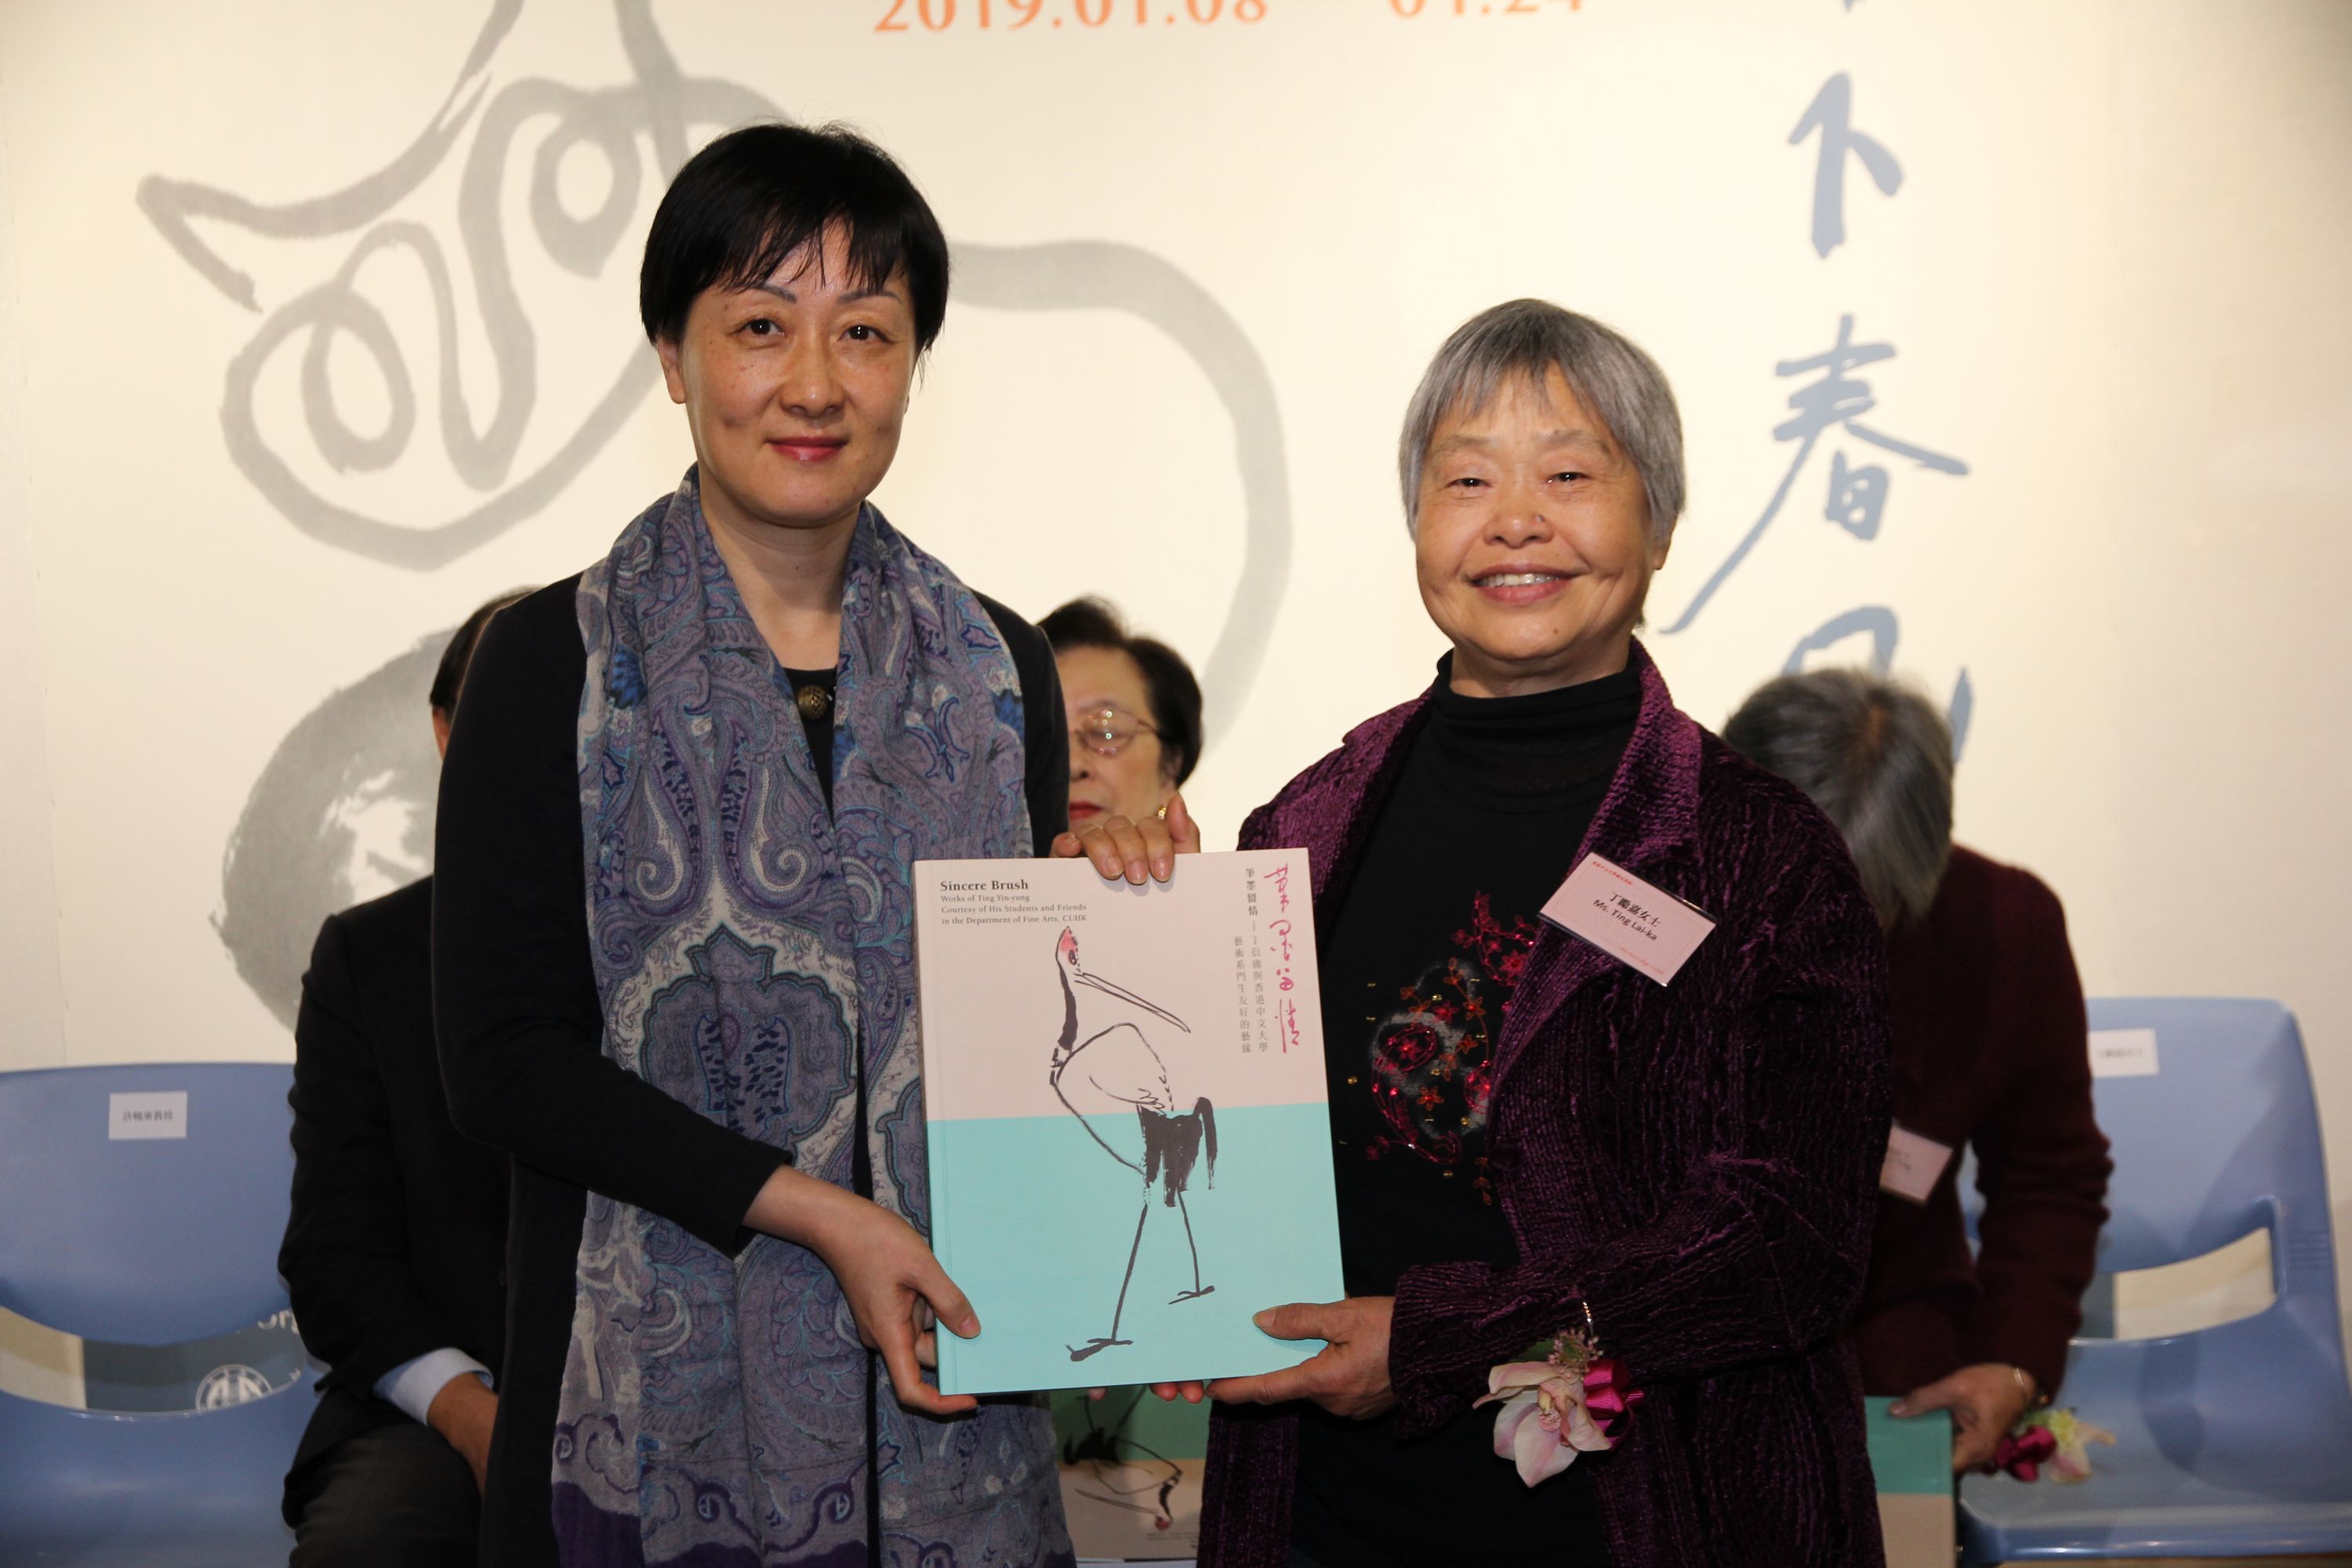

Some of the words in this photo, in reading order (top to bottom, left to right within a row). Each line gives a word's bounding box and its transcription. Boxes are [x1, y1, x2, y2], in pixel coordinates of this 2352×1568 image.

[940, 880, 987, 891] Sincere
[991, 879, 1029, 891] Brush
[966, 916, 1011, 926] Department
[1593, 899, 1608, 913] Ms.
[1612, 909, 1631, 926] Ting
[1632, 921, 1657, 941] Lai-ka
